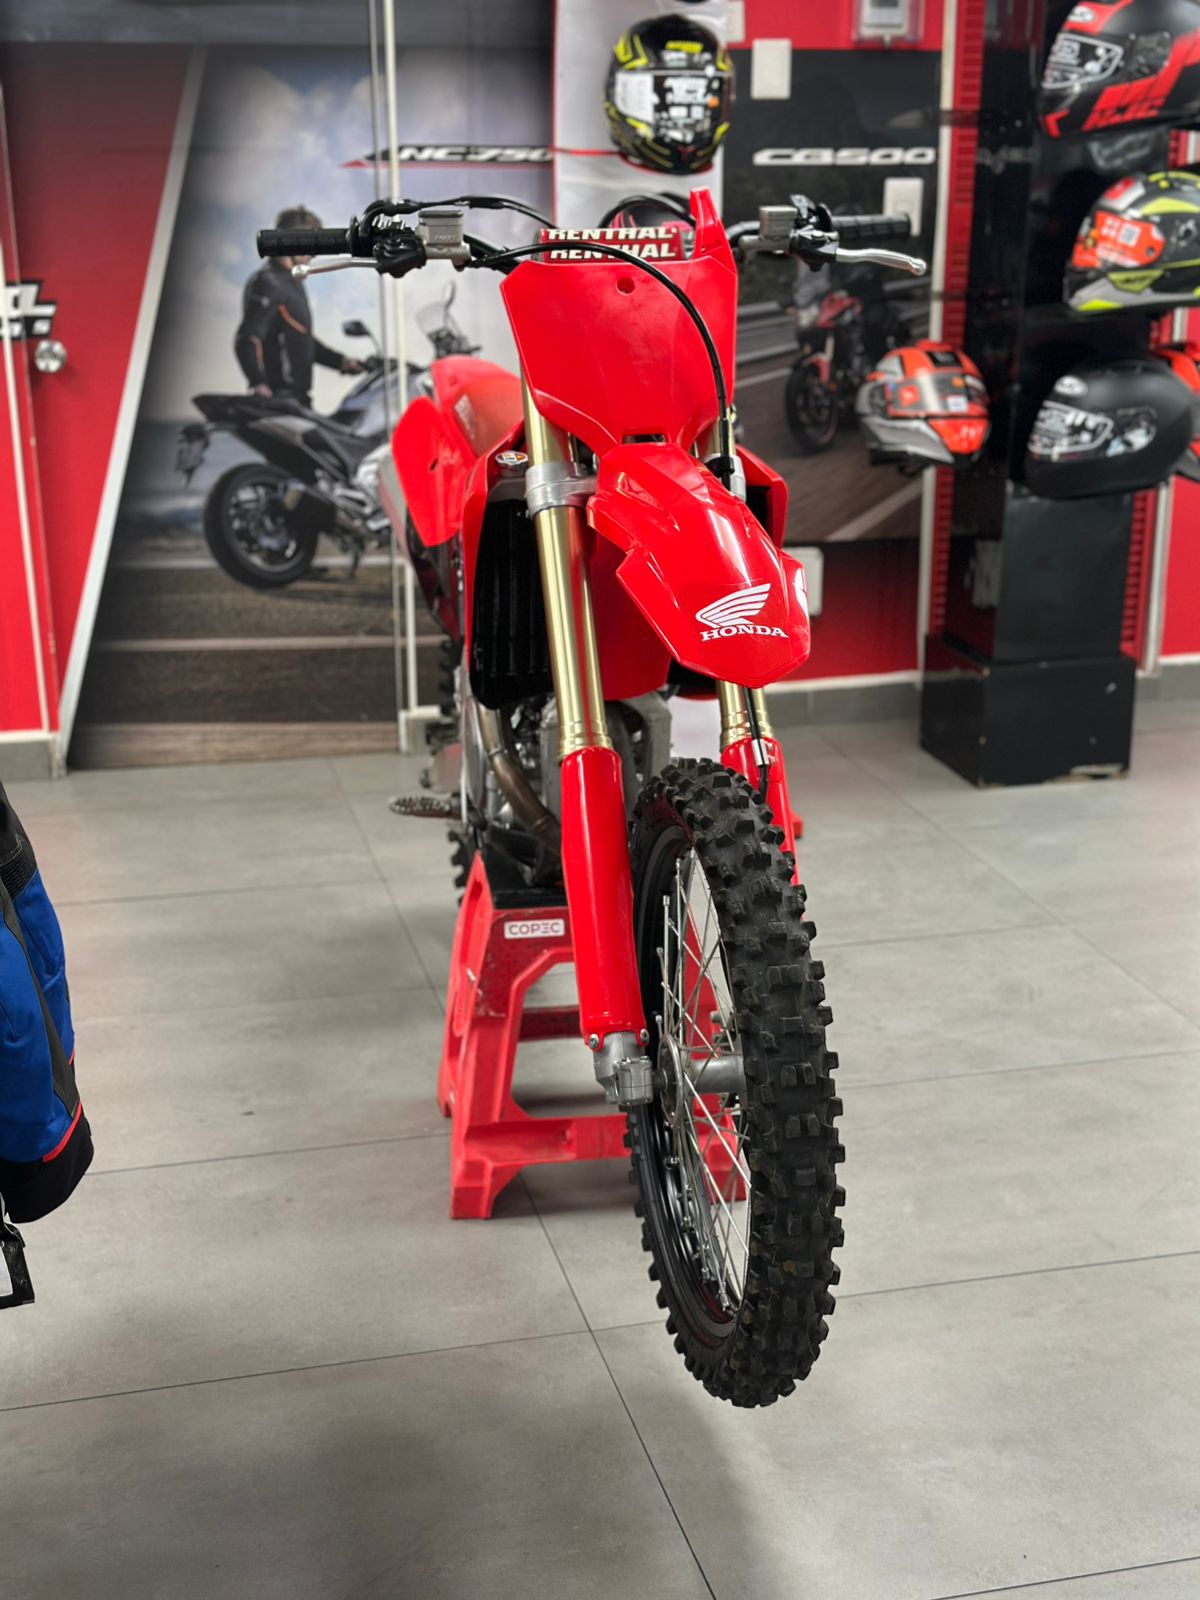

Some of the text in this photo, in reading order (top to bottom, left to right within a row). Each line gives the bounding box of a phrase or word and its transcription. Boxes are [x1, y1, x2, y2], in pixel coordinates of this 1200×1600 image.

[548, 228, 674, 240] RENTHAL
[700, 624, 789, 641] HONDA
[508, 922, 561, 936] COPEC
